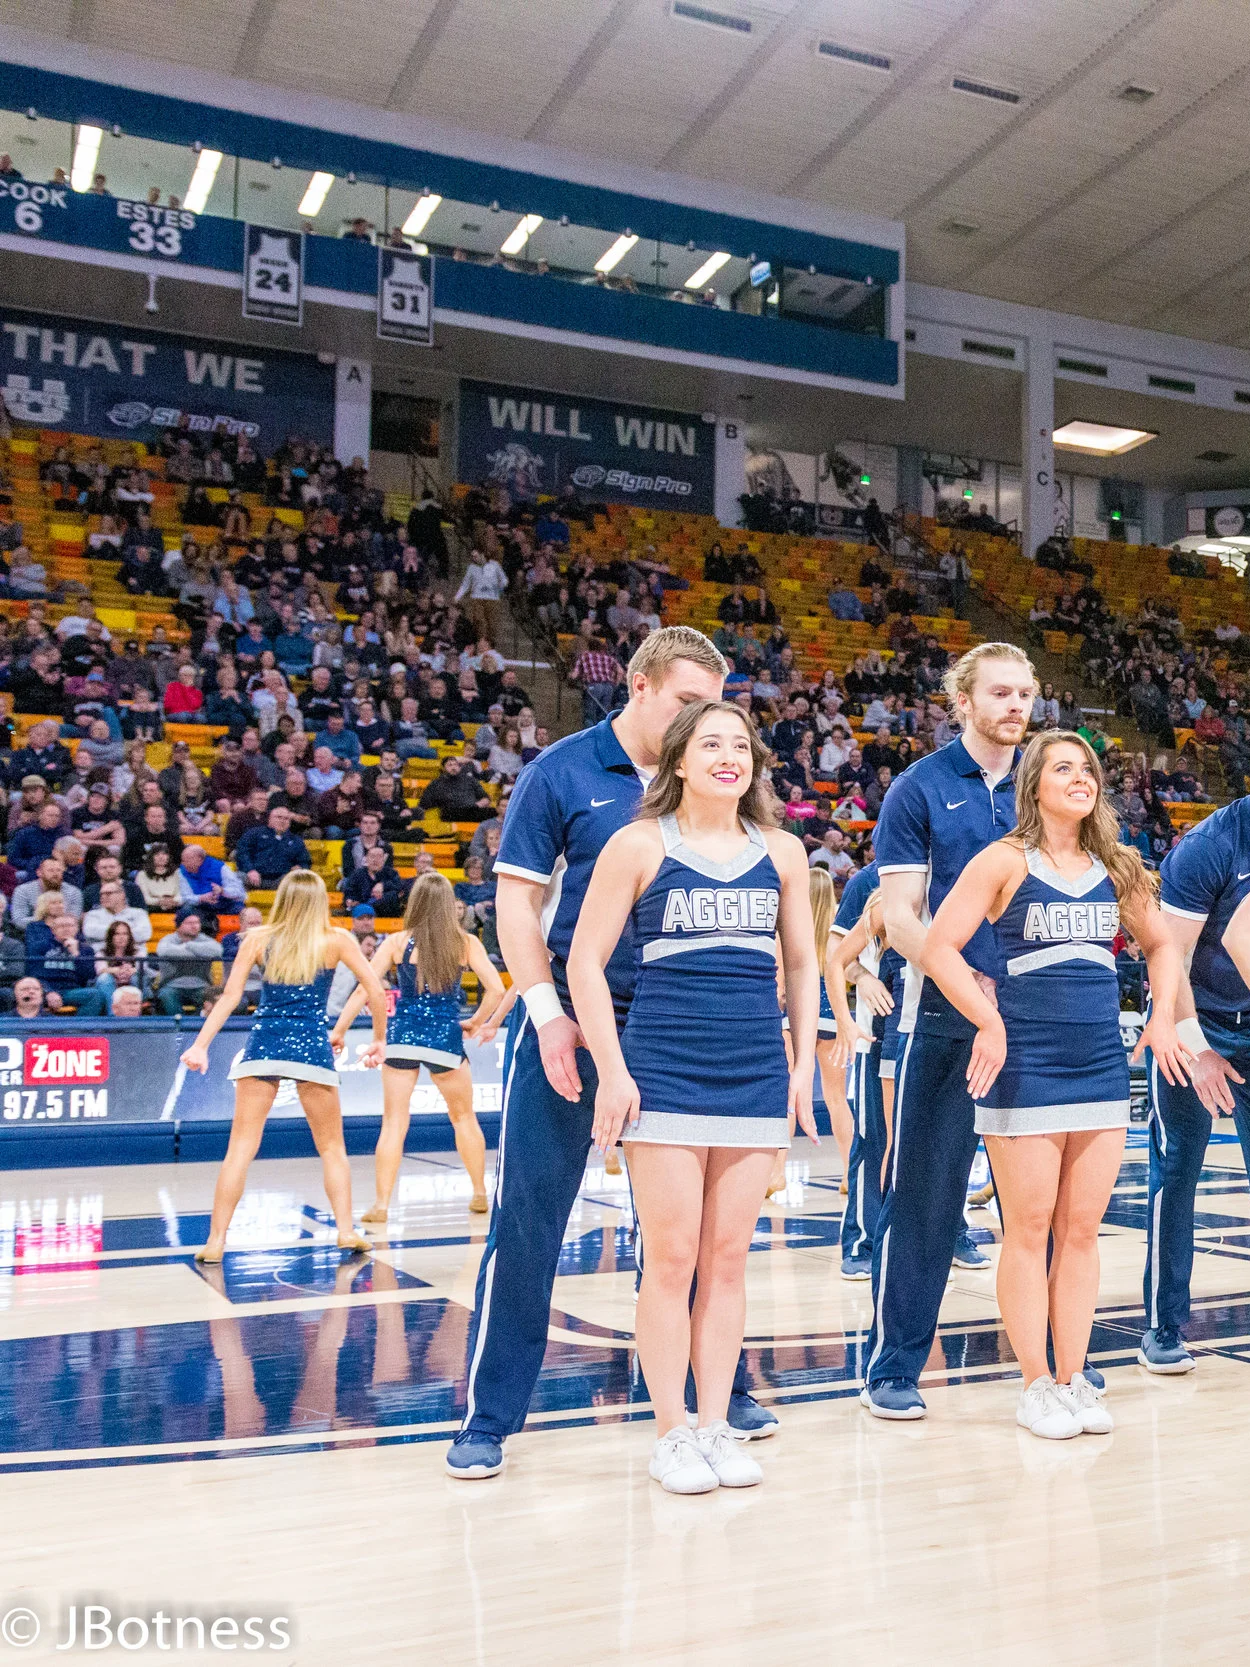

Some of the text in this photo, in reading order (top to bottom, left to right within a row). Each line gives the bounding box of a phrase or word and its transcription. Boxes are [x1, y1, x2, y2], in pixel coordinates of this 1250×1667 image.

[14, 201, 43, 232] 6
[117, 201, 196, 230] ESTES
[128, 221, 182, 256] 33
[255, 269, 292, 293] 24
[391, 292, 420, 314] 31
[3, 323, 264, 393] THAT WE
[346, 366, 361, 382] A
[487, 397, 695, 456] WILL WIN
[725, 424, 738, 439] B
[604, 469, 693, 496] Sign Pro
[1037, 471, 1049, 486] C
[662, 887, 780, 933] AGGIES
[31, 1050, 102, 1078] ZONE
[3, 1088, 108, 1120] 97.5 FM
